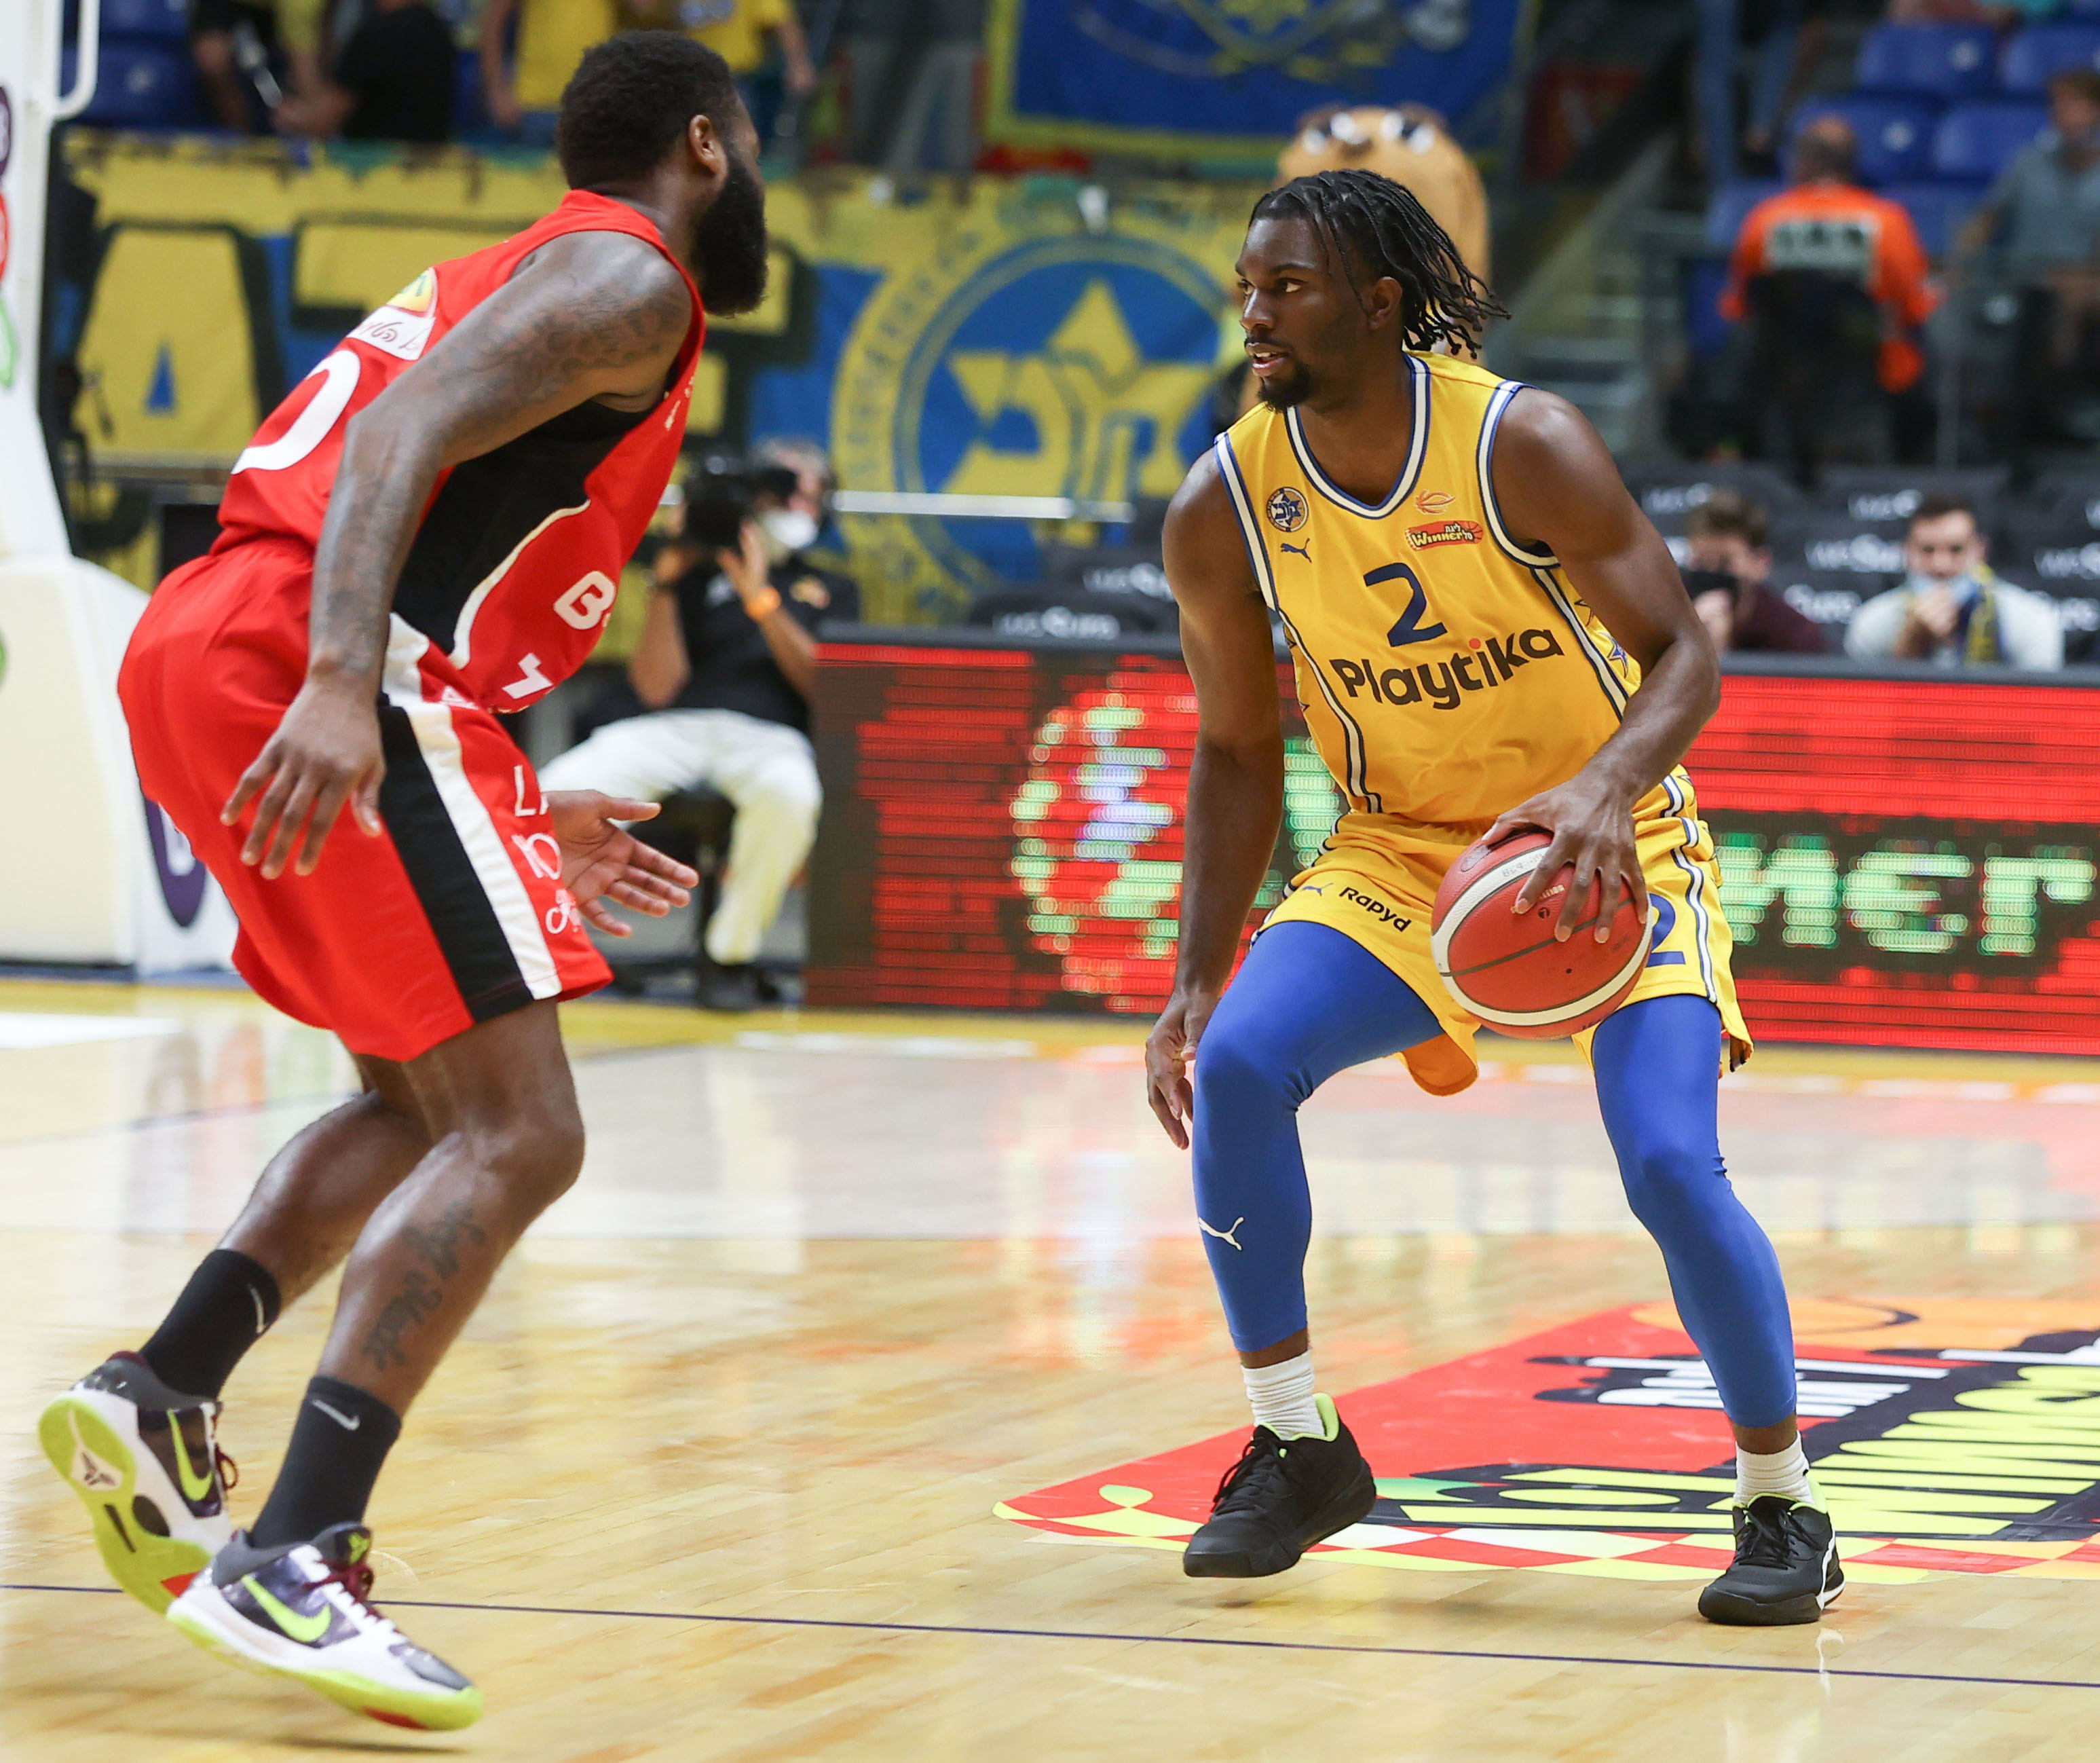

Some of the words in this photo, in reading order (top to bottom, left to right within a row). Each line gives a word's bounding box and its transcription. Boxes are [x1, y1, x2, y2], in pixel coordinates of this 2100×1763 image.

[1411, 532, 1463, 546] Winner
[1363, 562, 1448, 647] 2
[1329, 628, 1564, 710] Playtika
[1338, 887, 1412, 933] Rapyd
[1645, 893, 1686, 968] 2
